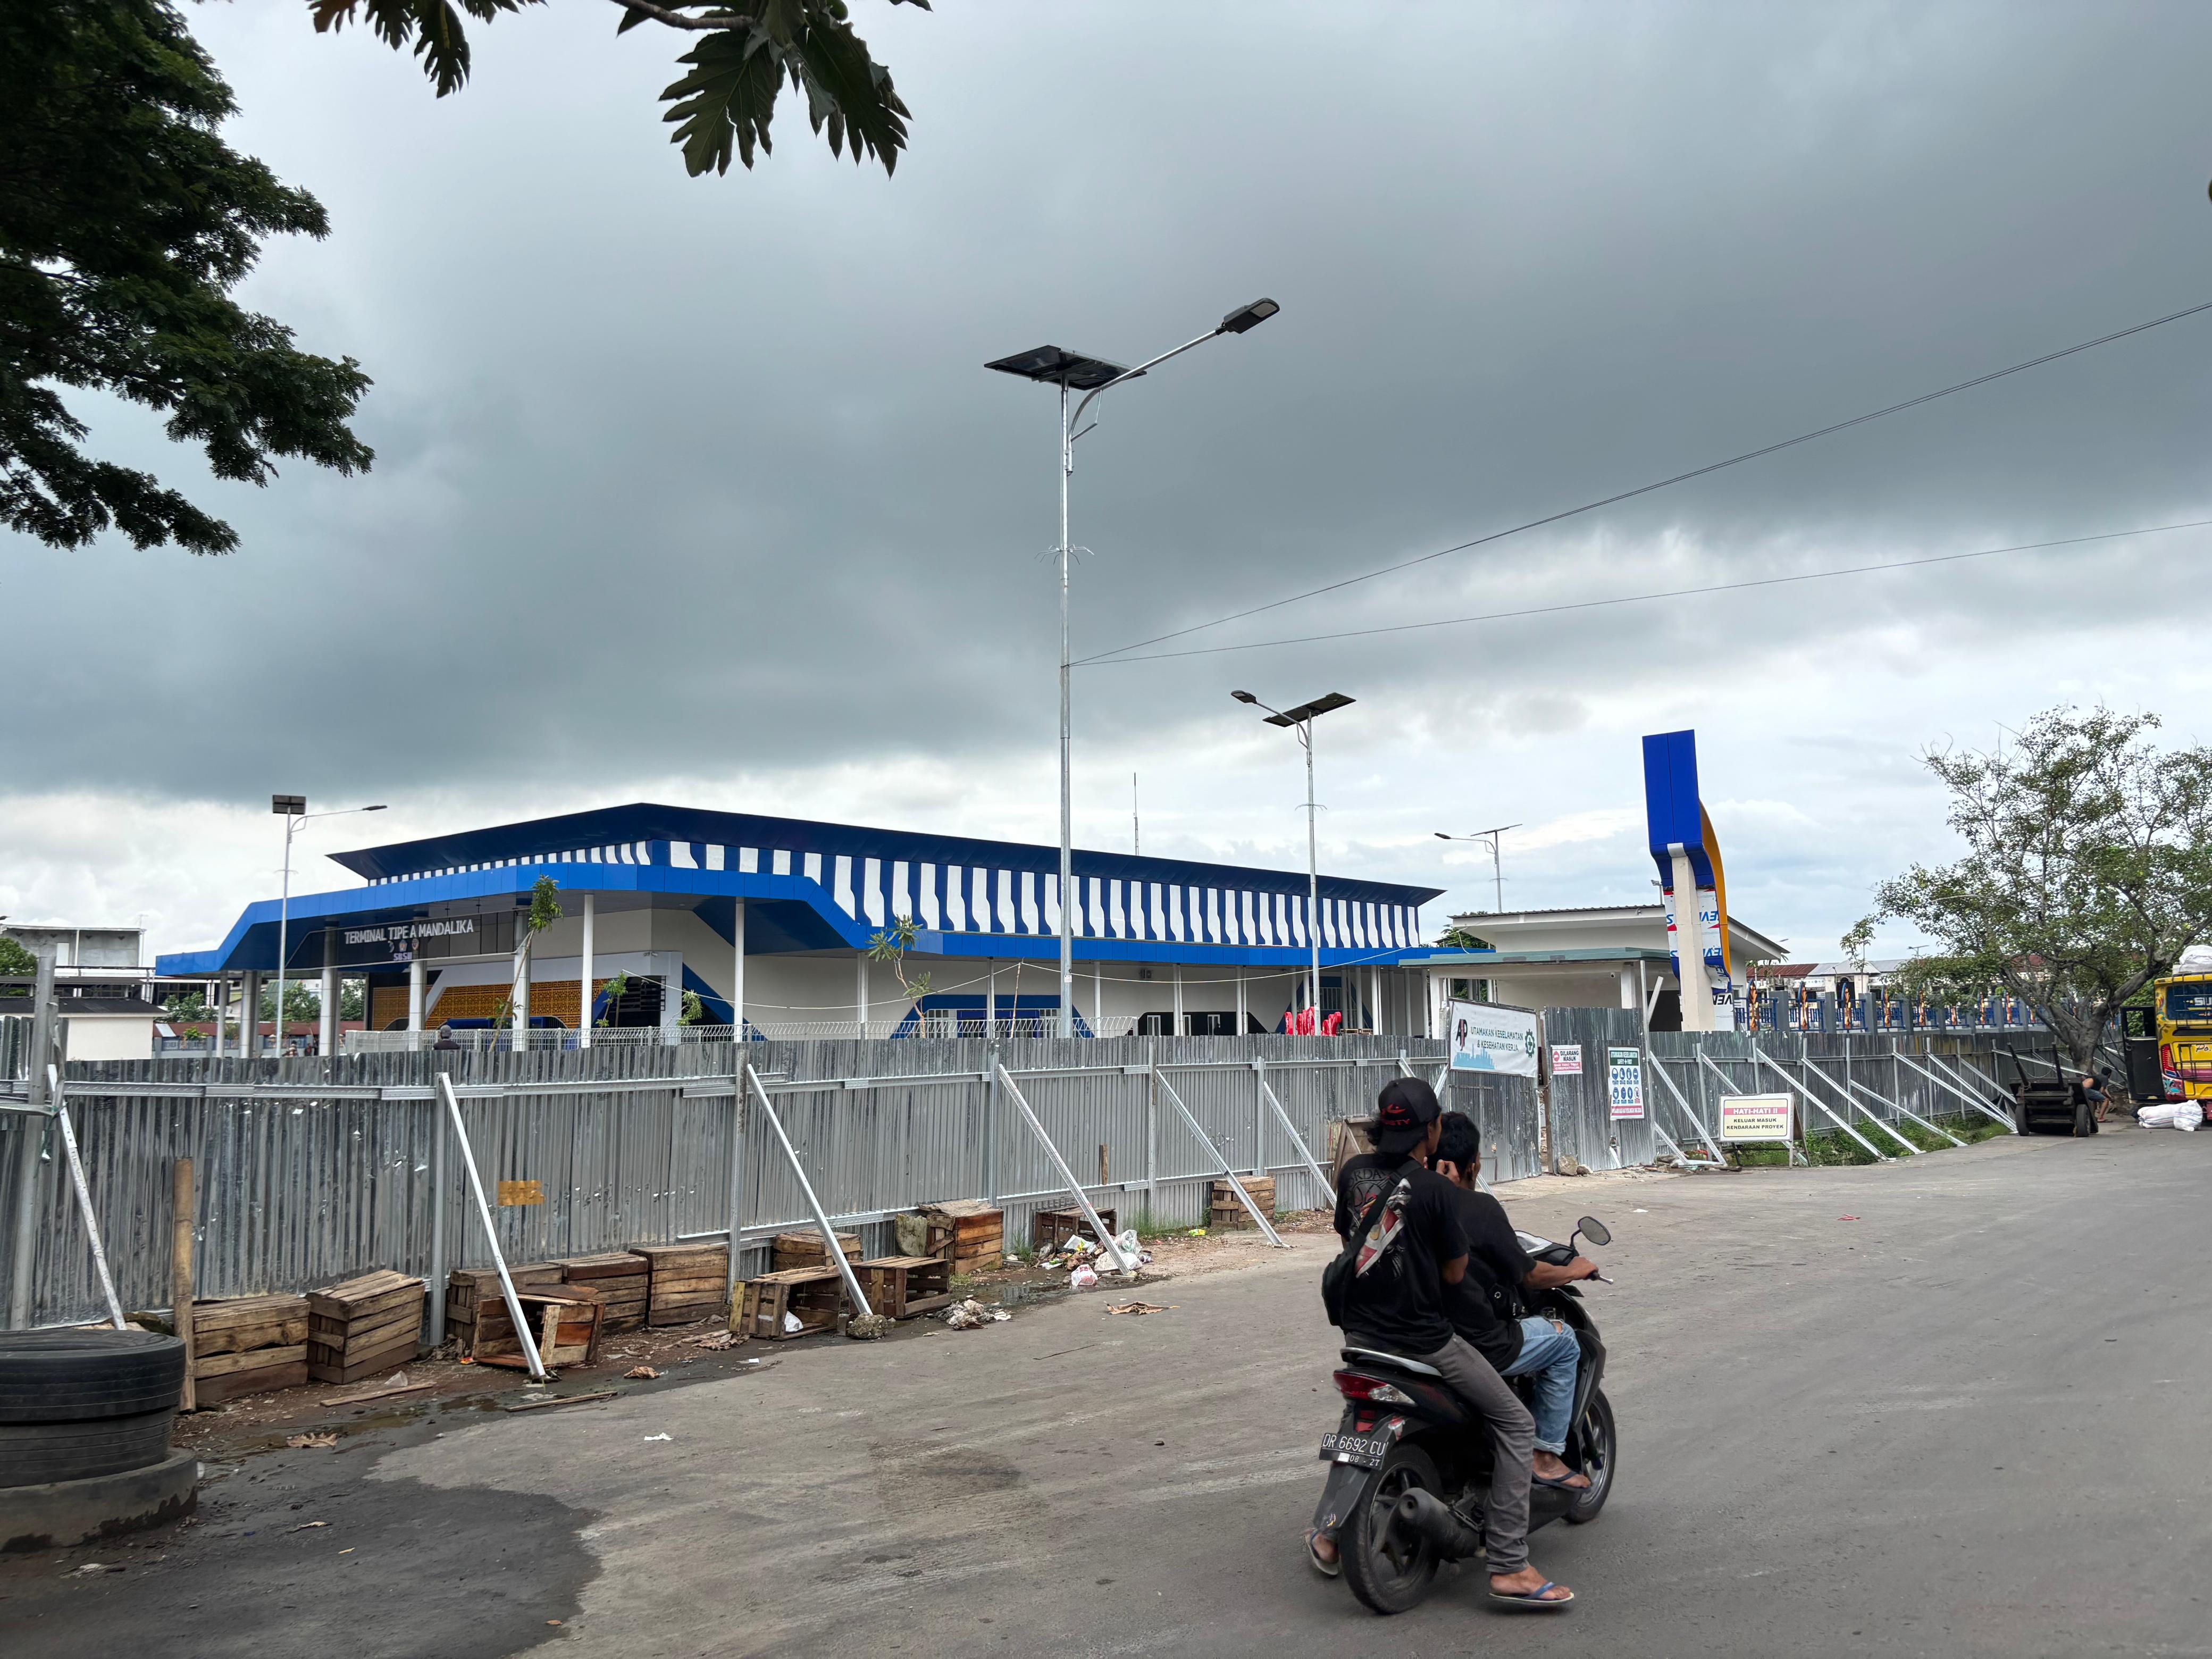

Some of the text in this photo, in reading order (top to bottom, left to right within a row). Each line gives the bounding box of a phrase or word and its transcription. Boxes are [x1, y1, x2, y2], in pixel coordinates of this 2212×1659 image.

[345, 919, 474, 944] TERMINAL TIPE A MANDALIKA
[1471, 1026, 1523, 1041] UTAMAKAN KESELAMATAN
[1481, 1040, 1505, 1050] KESEHATAN
[1505, 1043, 1519, 1052] KERJA
[1322, 1434, 1337, 1448] DR
[1339, 1436, 1367, 1453] 6692
